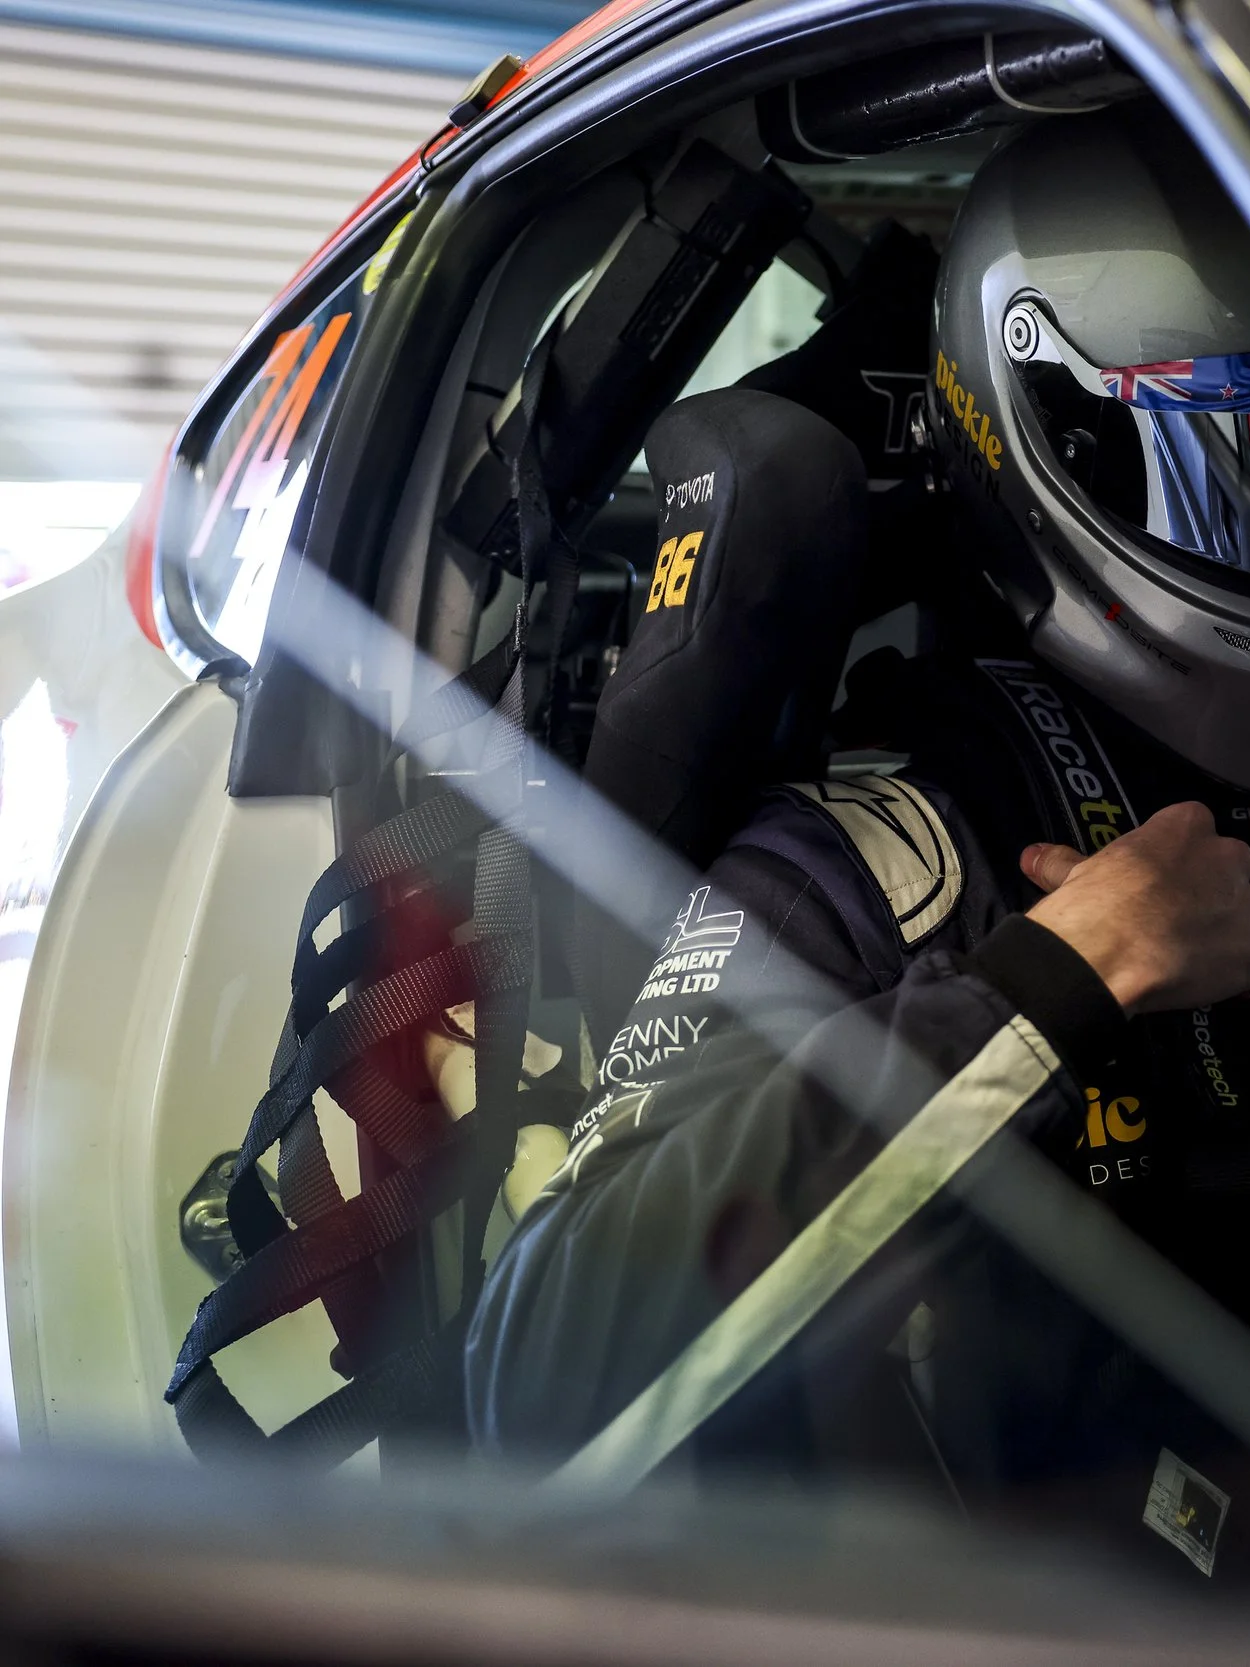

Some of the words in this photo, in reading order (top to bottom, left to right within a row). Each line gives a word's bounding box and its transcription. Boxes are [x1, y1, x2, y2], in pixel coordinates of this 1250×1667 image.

[676, 471, 716, 509] TOYOTA
[645, 530, 705, 614] 86
[1004, 677, 1124, 851] Racete
[645, 950, 732, 985] OPMENT
[680, 972, 721, 995] LTD
[609, 1015, 710, 1054] ENNY
[570, 1091, 615, 1142] ncret
[1076, 1086, 1148, 1150] ic
